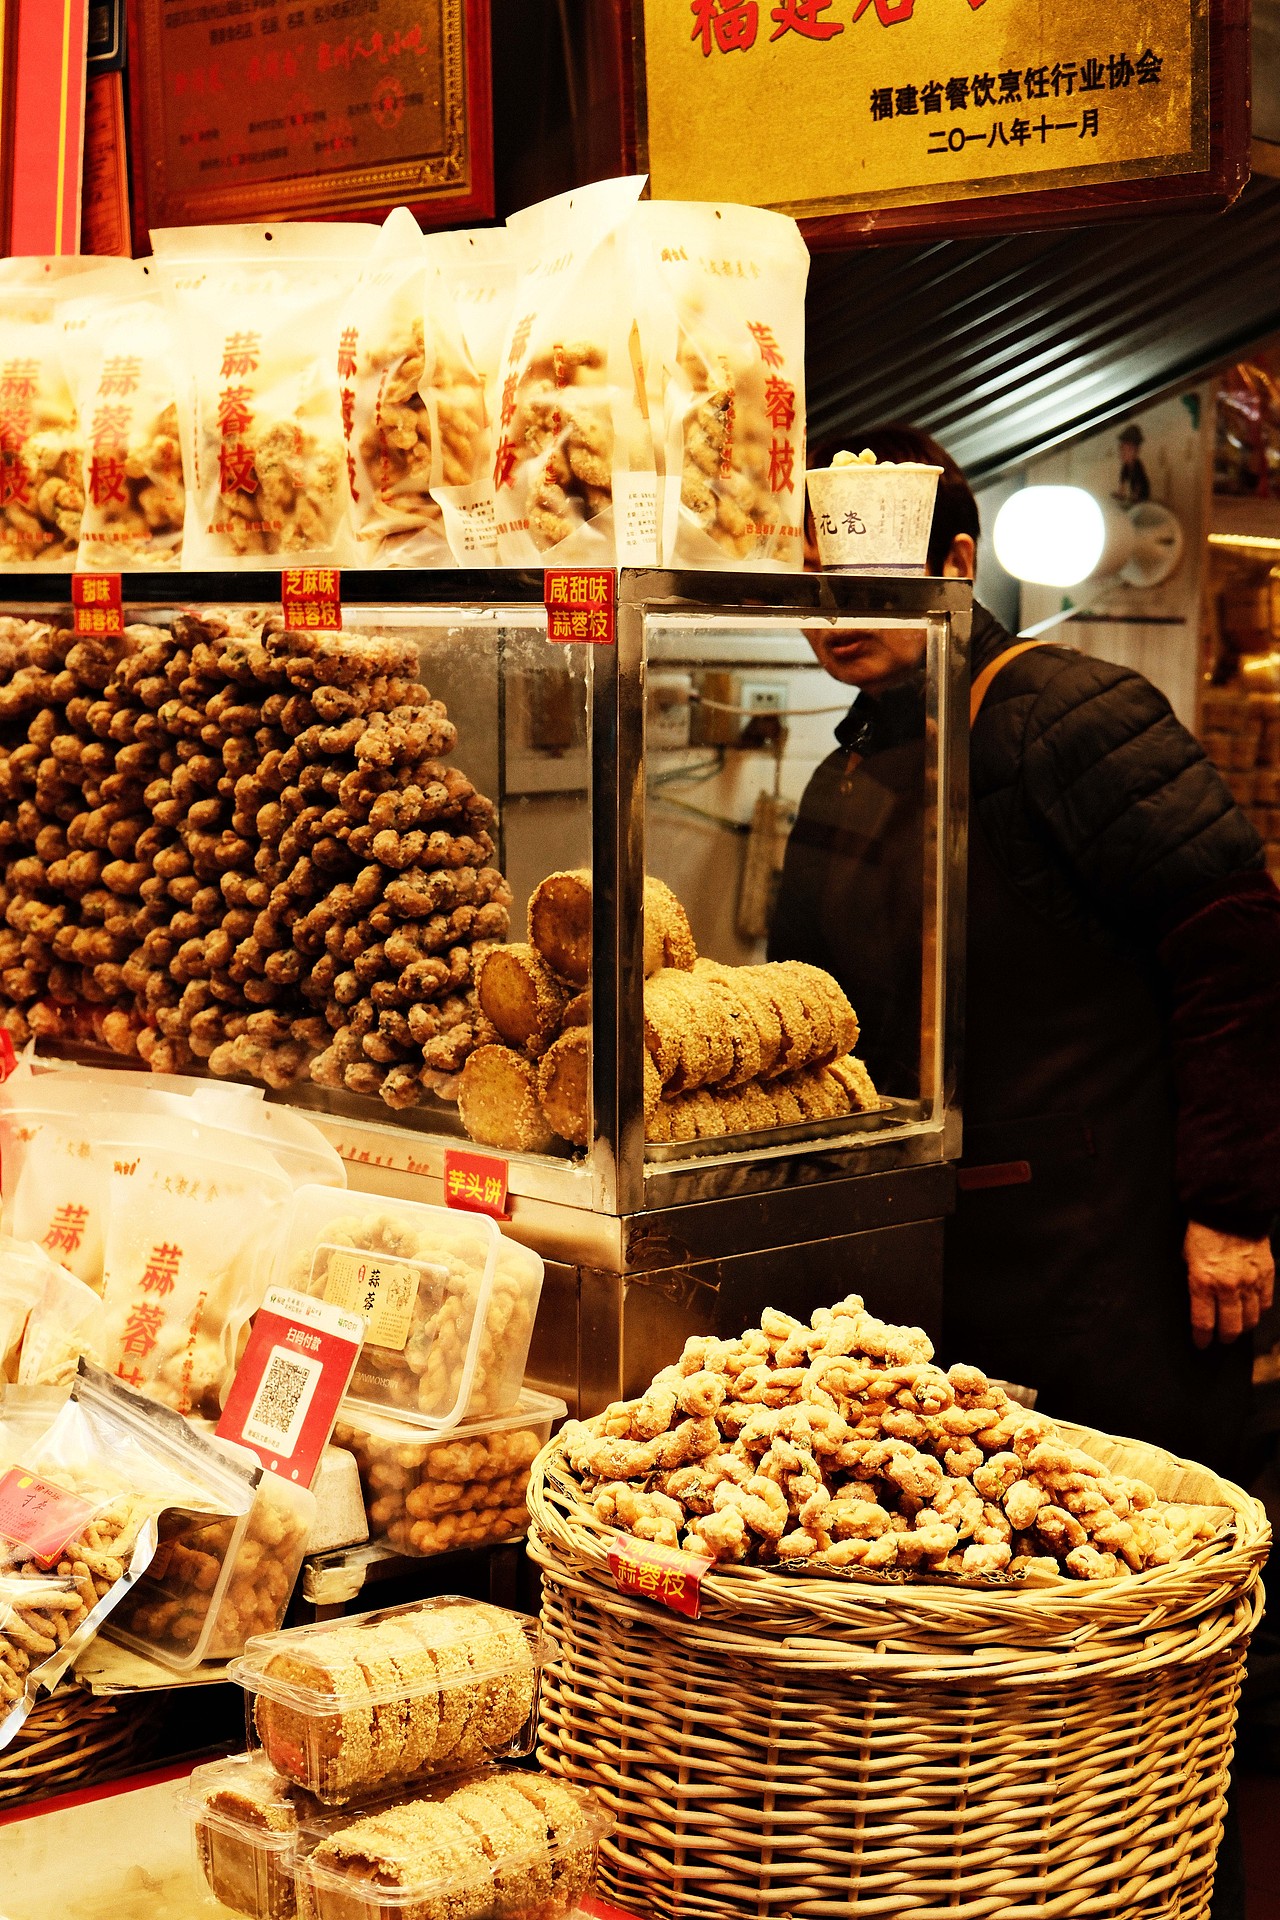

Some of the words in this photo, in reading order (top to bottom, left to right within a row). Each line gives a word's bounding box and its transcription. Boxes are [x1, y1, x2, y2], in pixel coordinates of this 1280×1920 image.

[869, 48, 1164, 122] 福建省餐饮烹饪行业协会
[217, 330, 262, 494] 蒜蓉枝
[745, 319, 795, 494] 蒜蓉枝
[0, 357, 42, 505] 蒜蓉枝
[88, 355, 143, 505] 蒜蓉枝
[812, 510, 867, 536] 花瓷
[82, 579, 111, 602] 甜味
[286, 570, 335, 595] 芝麻味
[550, 575, 608, 603] 咸甜味
[78, 608, 120, 632] 蒜蓉枝
[287, 601, 338, 627] 蒜蓉枝
[552, 609, 608, 638] 蒜蓉枝
[448, 1169, 502, 1205] 芋头饼
[360, 1268, 381, 1317] 蒜蓉
[286, 1327, 322, 1352] 扫码付款
[617, 1555, 687, 1599] 蒜蓉枝
